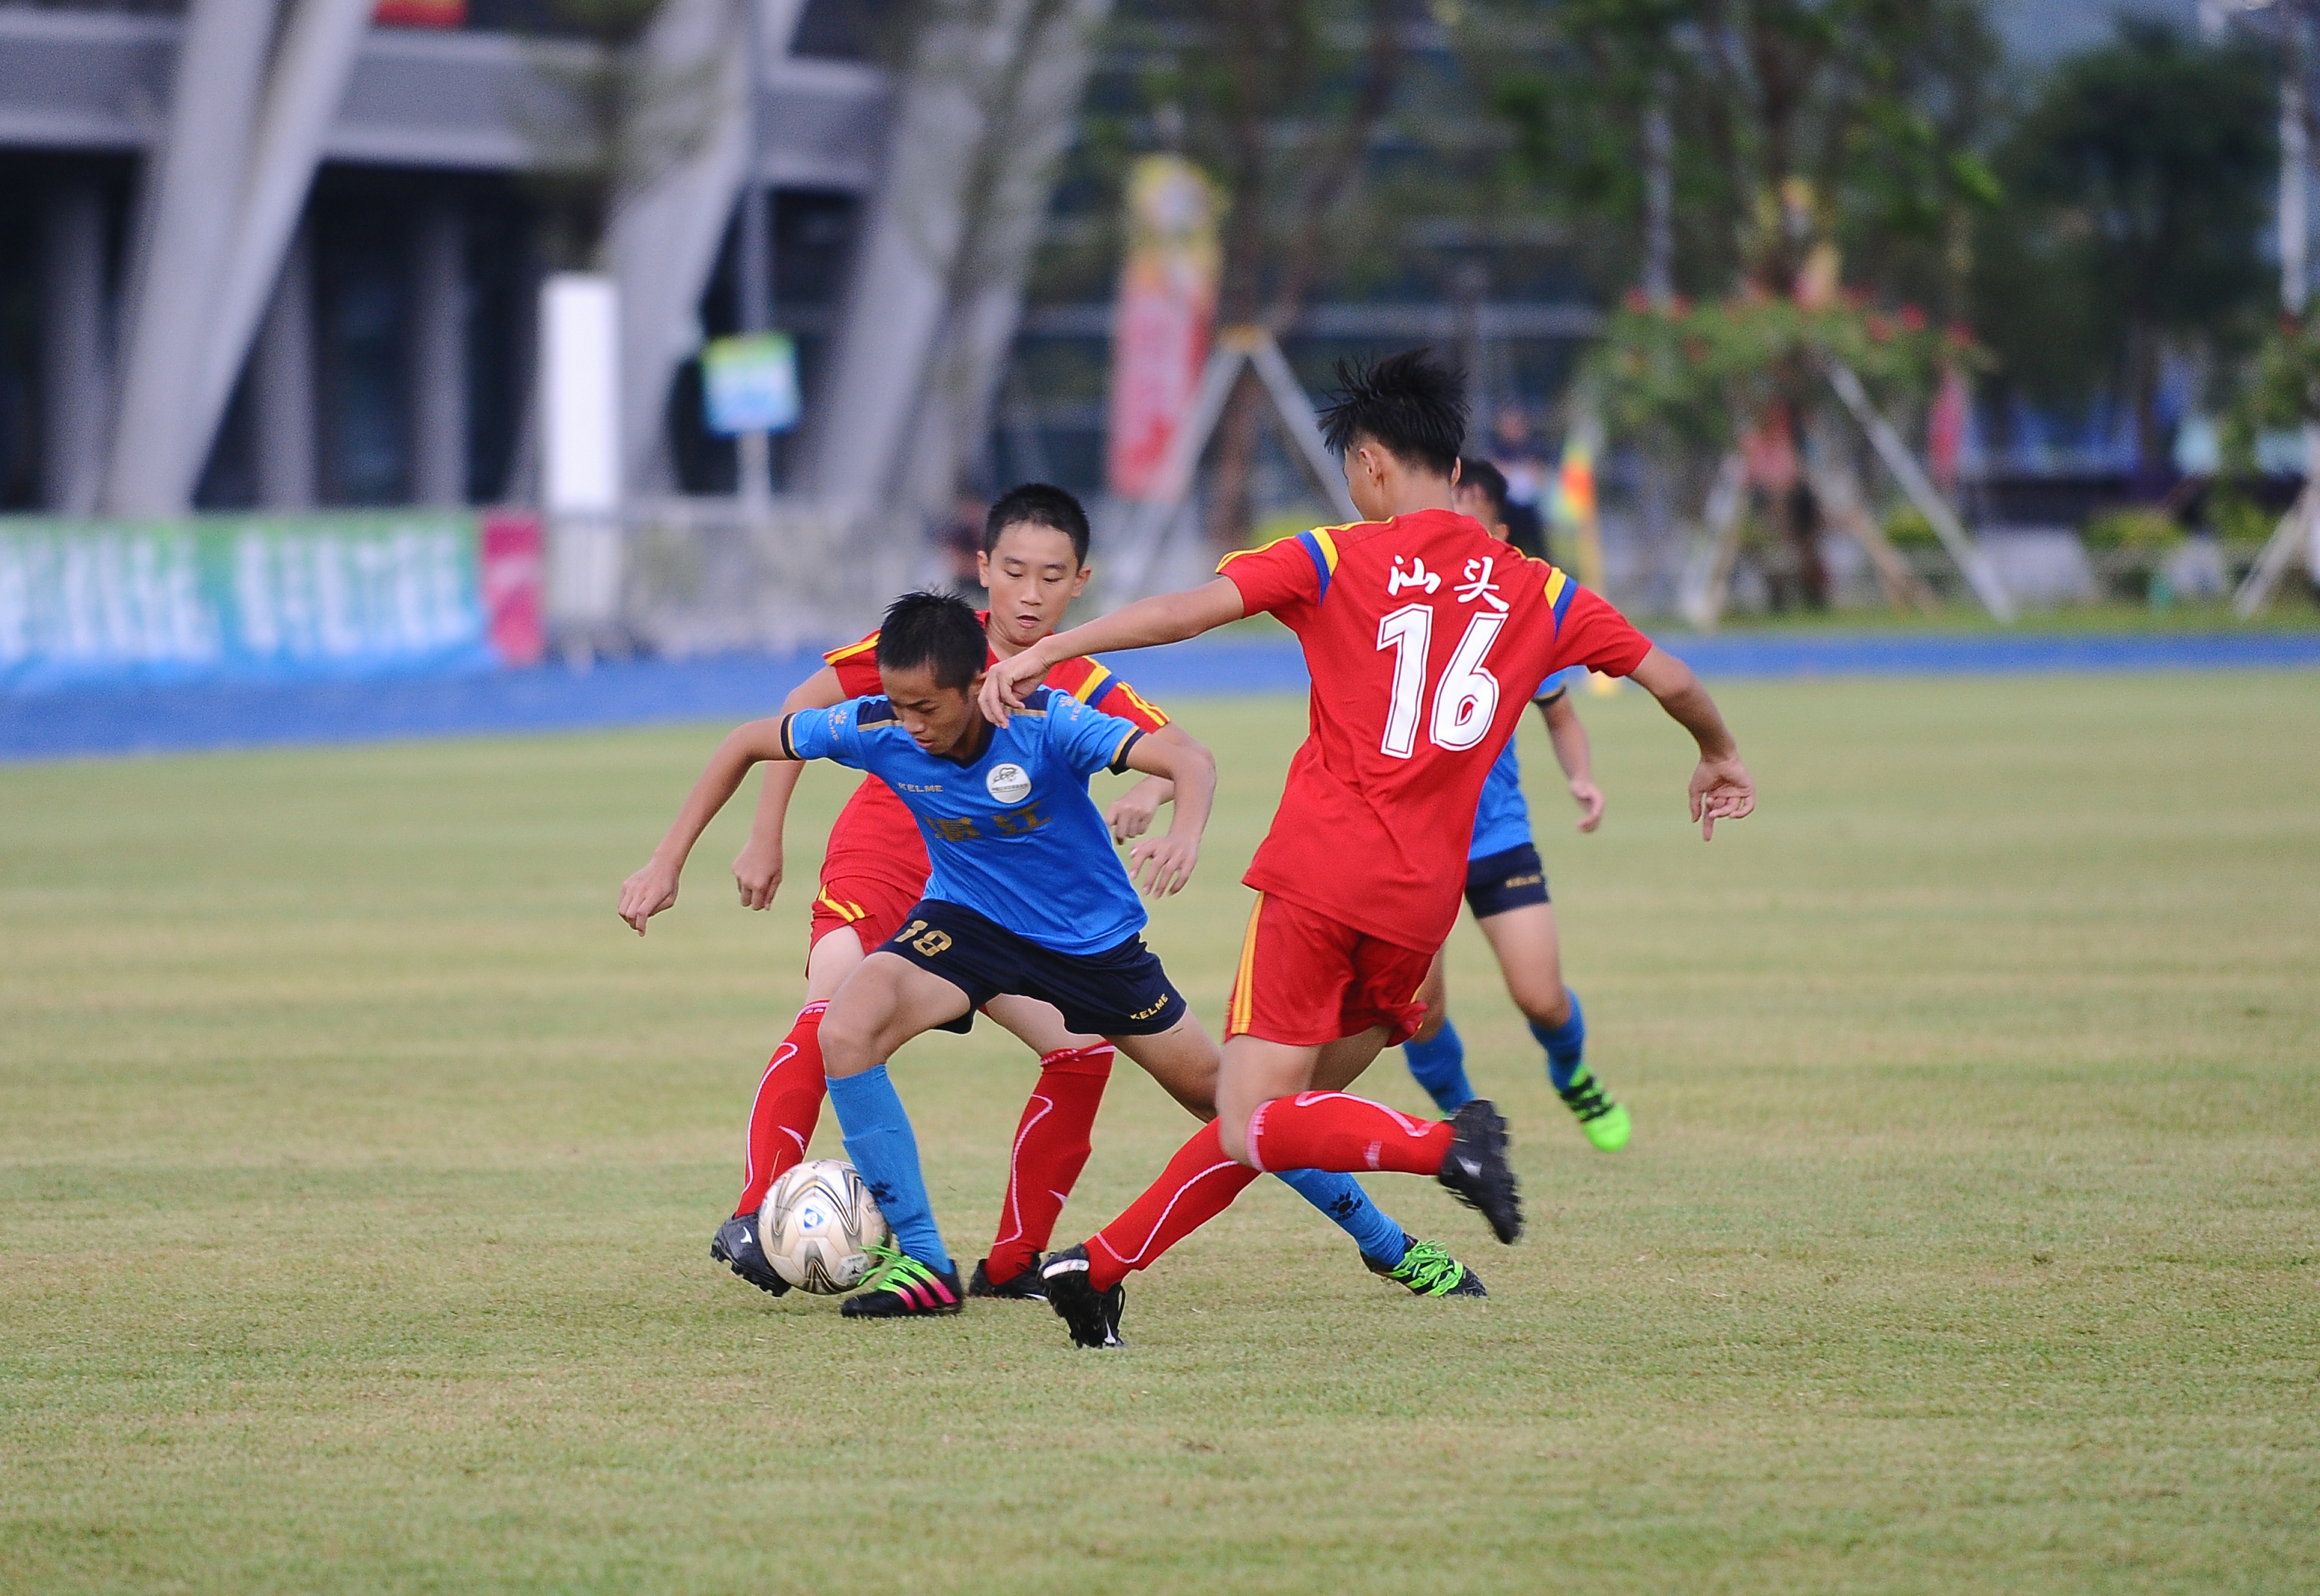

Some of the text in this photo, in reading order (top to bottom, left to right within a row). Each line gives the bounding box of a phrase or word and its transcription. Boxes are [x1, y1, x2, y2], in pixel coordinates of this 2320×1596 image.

[1387, 554, 1510, 612] 汕头
[1376, 602, 1509, 759] 16
[898, 782, 943, 793] KELME
[1129, 993, 1169, 1019] KELME
